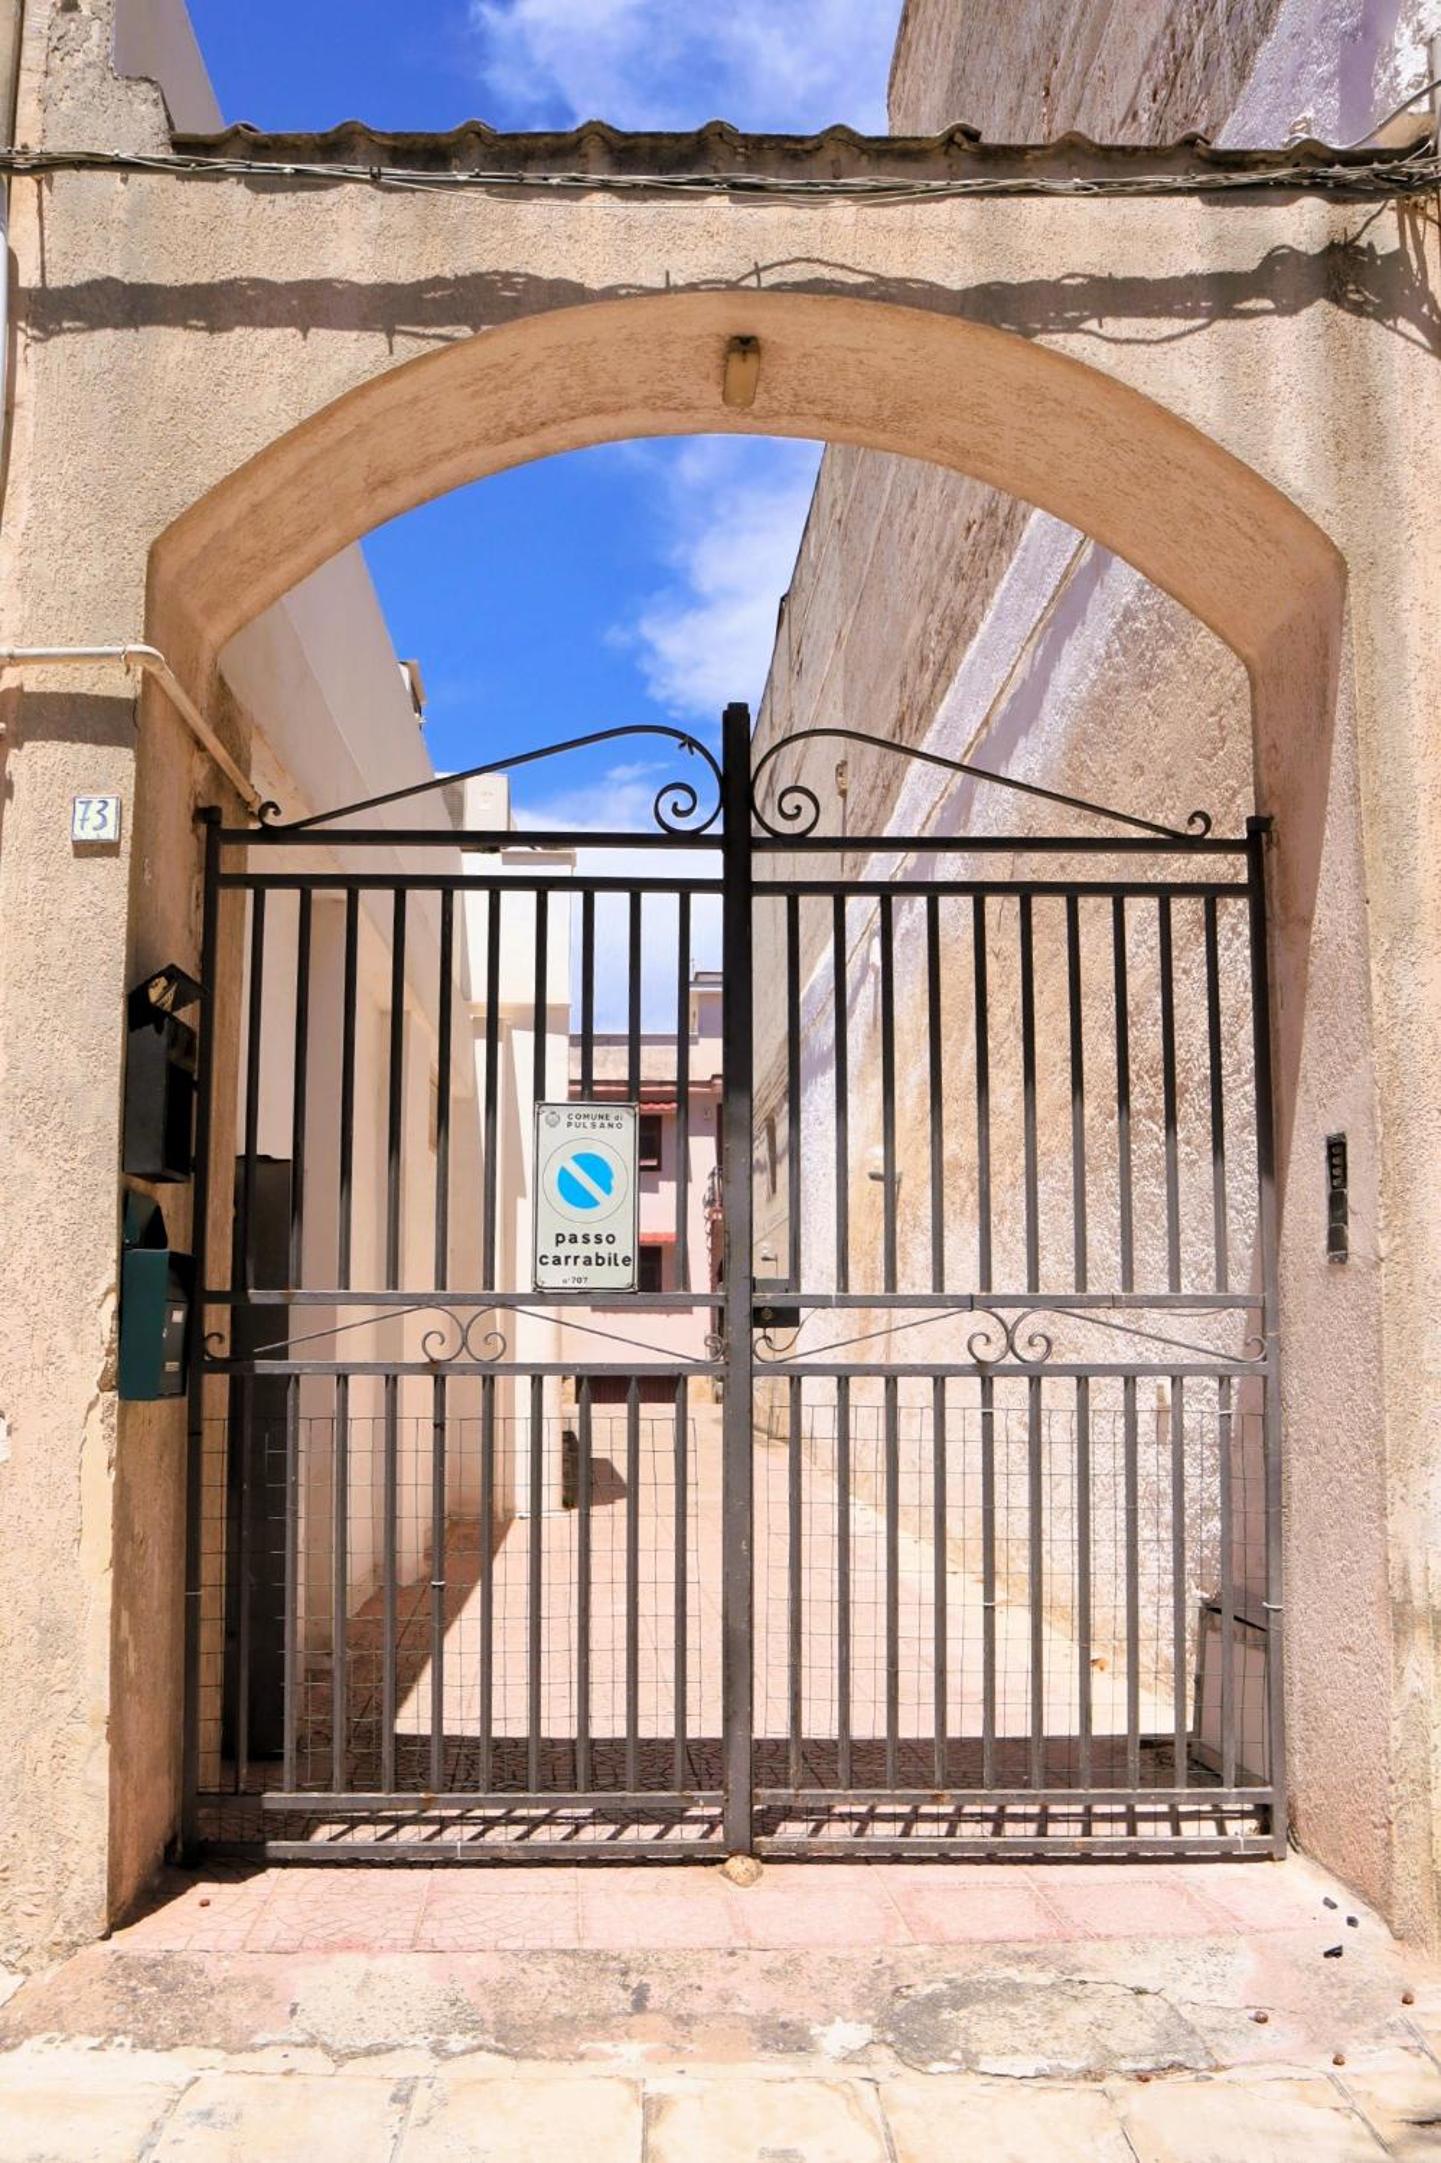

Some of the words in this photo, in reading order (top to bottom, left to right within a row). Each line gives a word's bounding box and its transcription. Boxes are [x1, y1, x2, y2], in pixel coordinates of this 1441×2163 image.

[78, 800, 109, 831] 73
[567, 1112, 610, 1121] COMUNE
[614, 1113, 623, 1121] di
[566, 1121, 623, 1129] PULSANO
[555, 1233, 616, 1247] passo
[539, 1251, 632, 1267] carrabile
